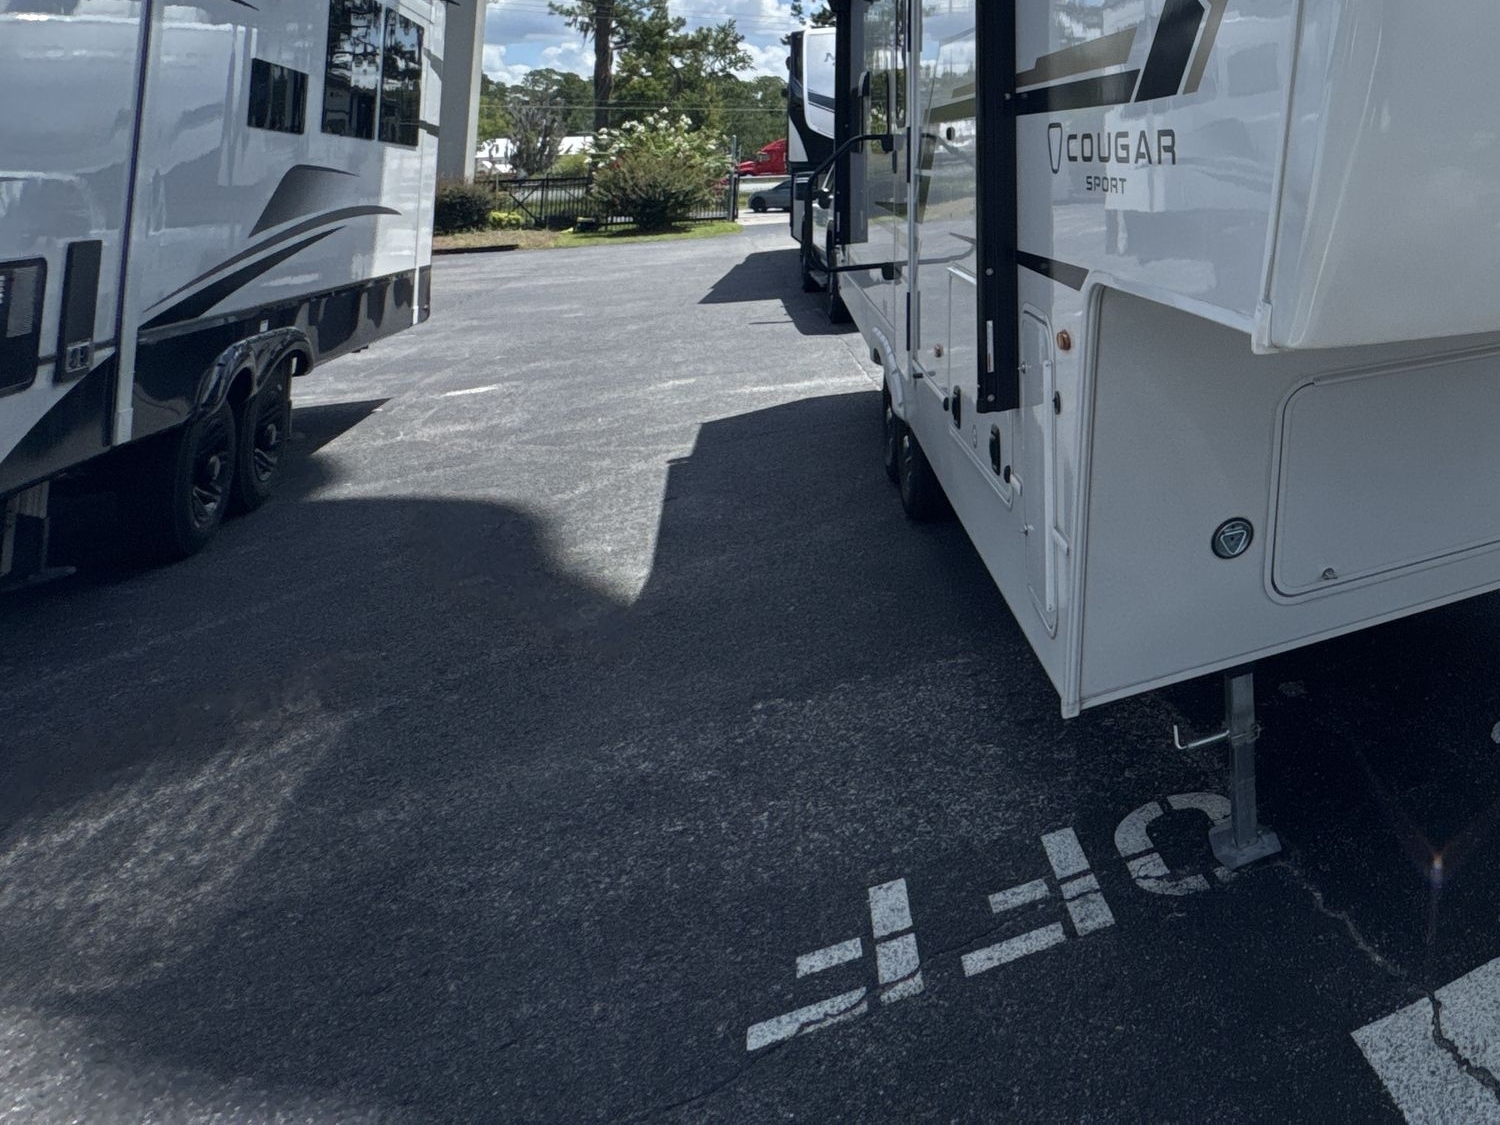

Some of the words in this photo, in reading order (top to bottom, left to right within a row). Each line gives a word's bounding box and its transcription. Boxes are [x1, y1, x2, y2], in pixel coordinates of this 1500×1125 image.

[1066, 128, 1177, 165] COUGAR
[1085, 175, 1127, 195] SPORT
[746, 791, 1237, 1051] OFF
